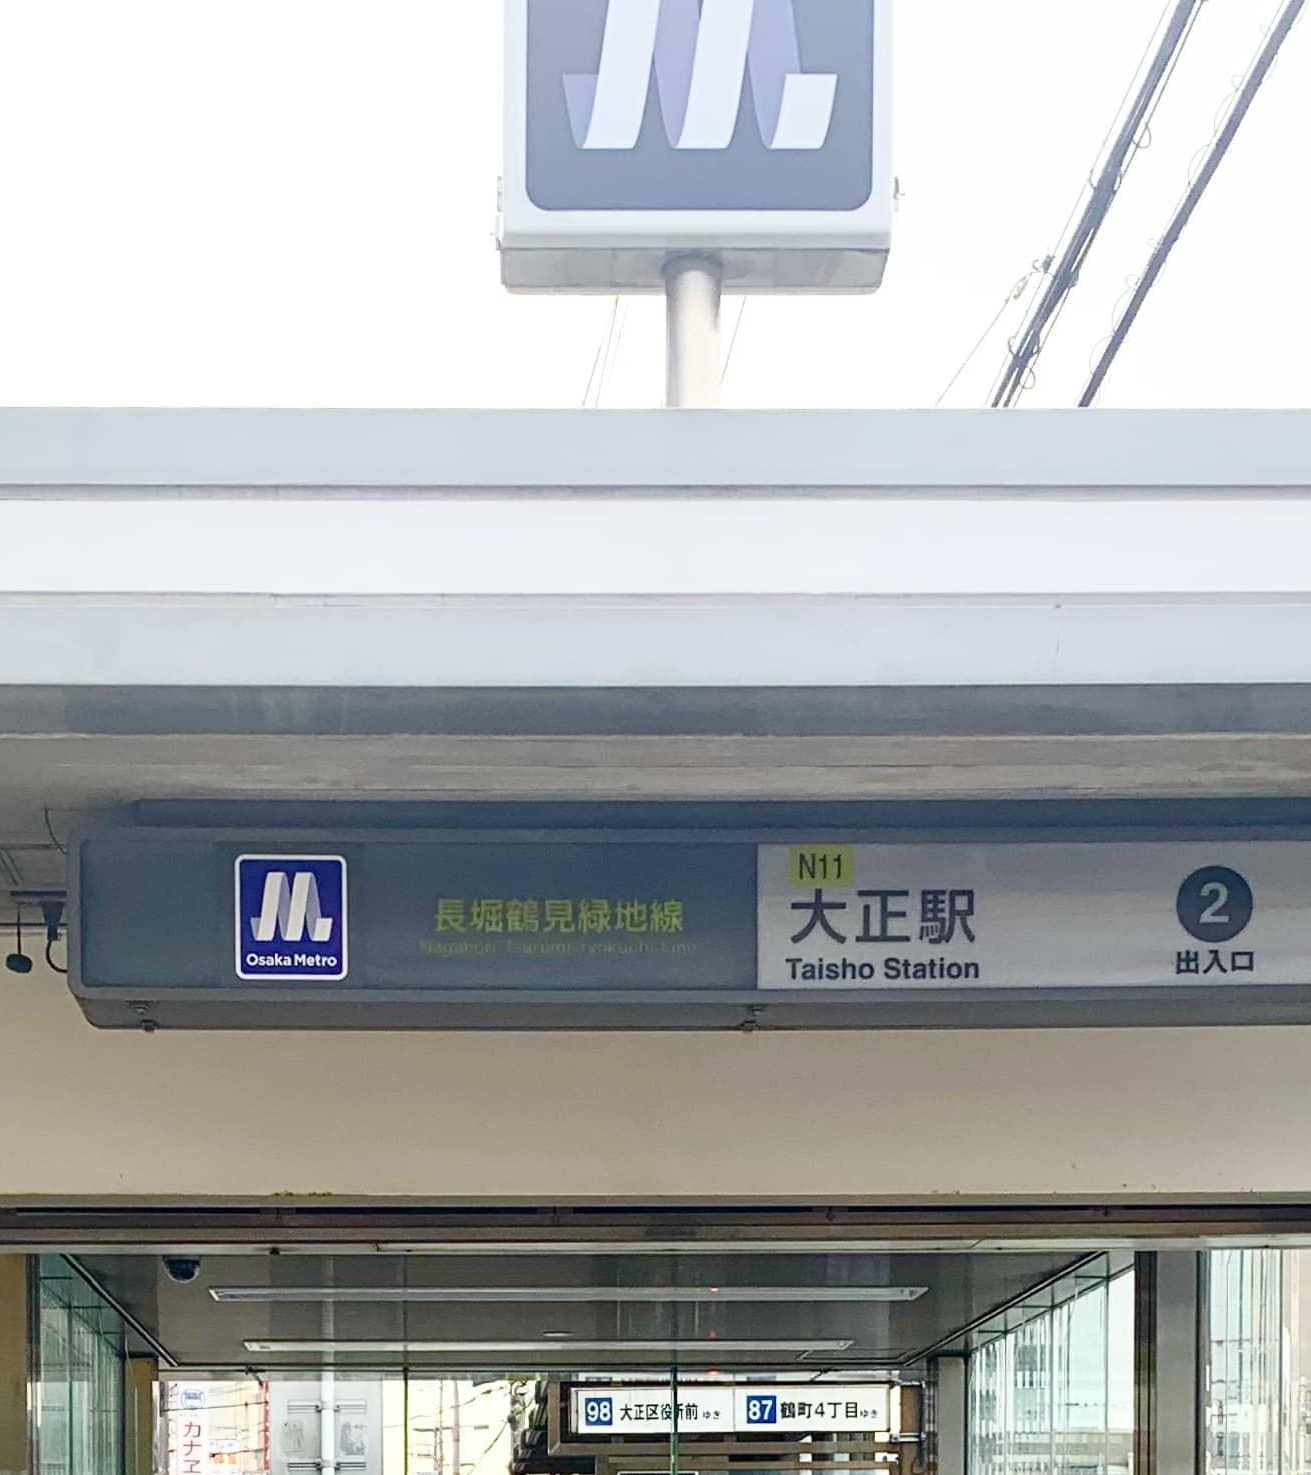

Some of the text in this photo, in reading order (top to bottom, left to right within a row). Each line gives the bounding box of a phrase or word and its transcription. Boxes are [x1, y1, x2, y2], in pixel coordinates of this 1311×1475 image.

[798, 853, 843, 880] N11
[1199, 881, 1230, 924] 2
[436, 899, 684, 934] 長堀鶴見緑地線
[790, 888, 976, 945] 大正駅
[246, 953, 338, 967] Osaka Metro
[785, 957, 980, 980] Taisho Station
[1176, 949, 1254, 975] 出入口
[586, 1401, 612, 1422] 98
[748, 1399, 774, 1421] 87
